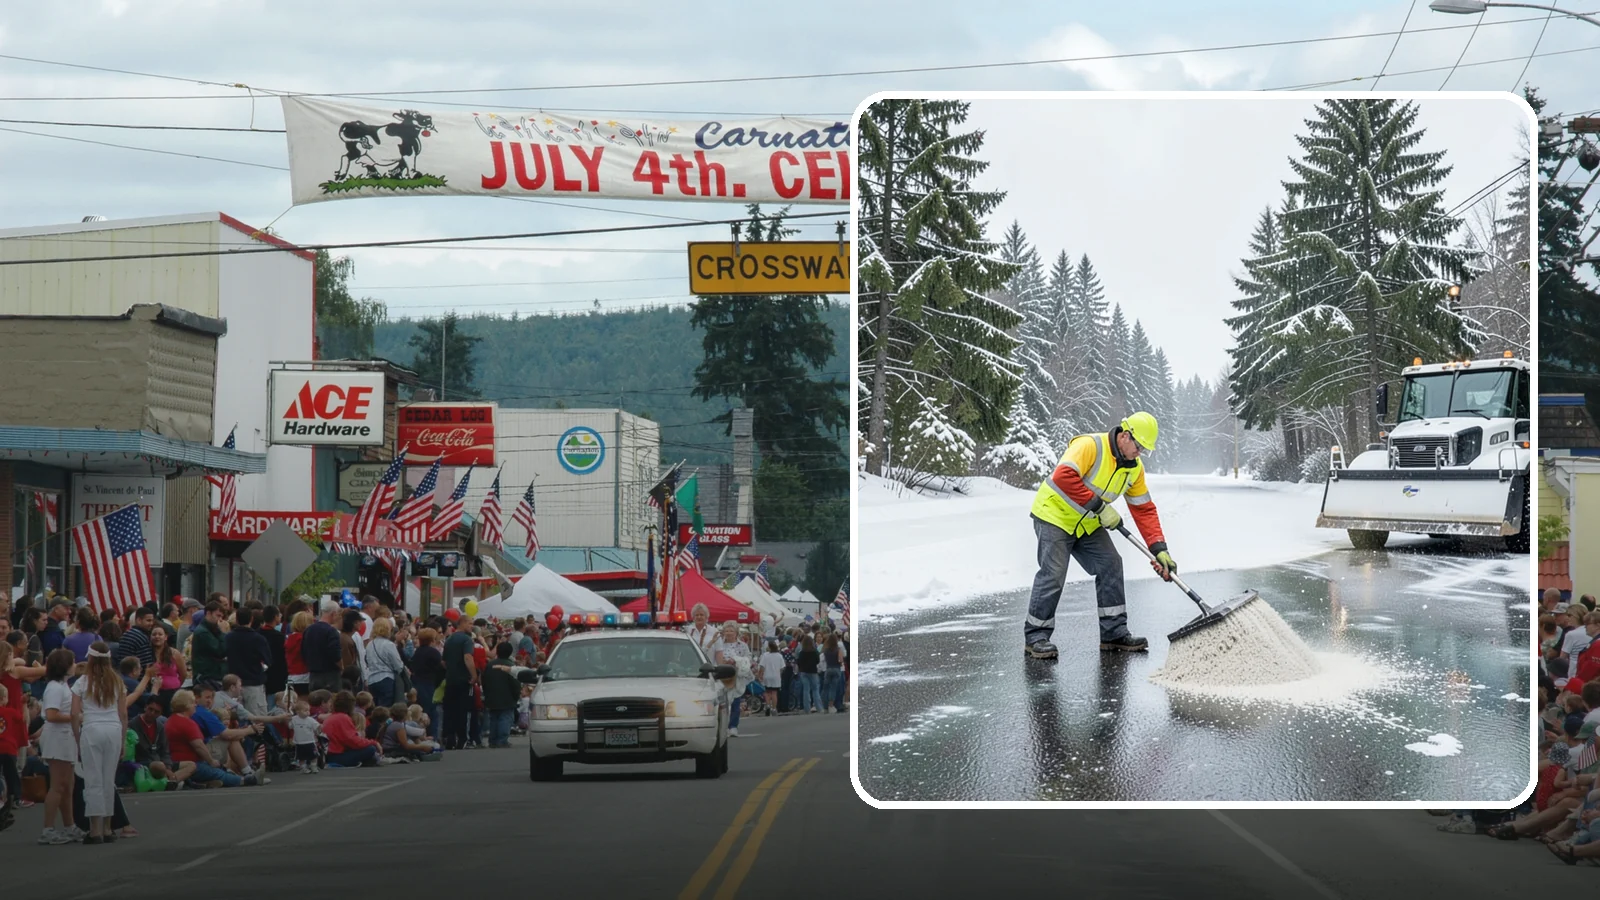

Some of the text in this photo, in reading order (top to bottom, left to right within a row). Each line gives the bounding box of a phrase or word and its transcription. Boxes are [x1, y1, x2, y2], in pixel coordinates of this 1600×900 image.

[481, 141, 604, 192] JULY
[633, 149, 746, 198] 4th.
[697, 254, 850, 280] CROSSWA
[283, 380, 373, 420] ACE
[405, 409, 485, 422] CEDAR LOG
[283, 421, 371, 436] Hardware
[416, 428, 477, 447] Coca-Cola
[95, 485, 125, 495] Vincent
[125, 486, 136, 495] de
[137, 486, 155, 495] Paul
[688, 526, 741, 535] CRNATION
